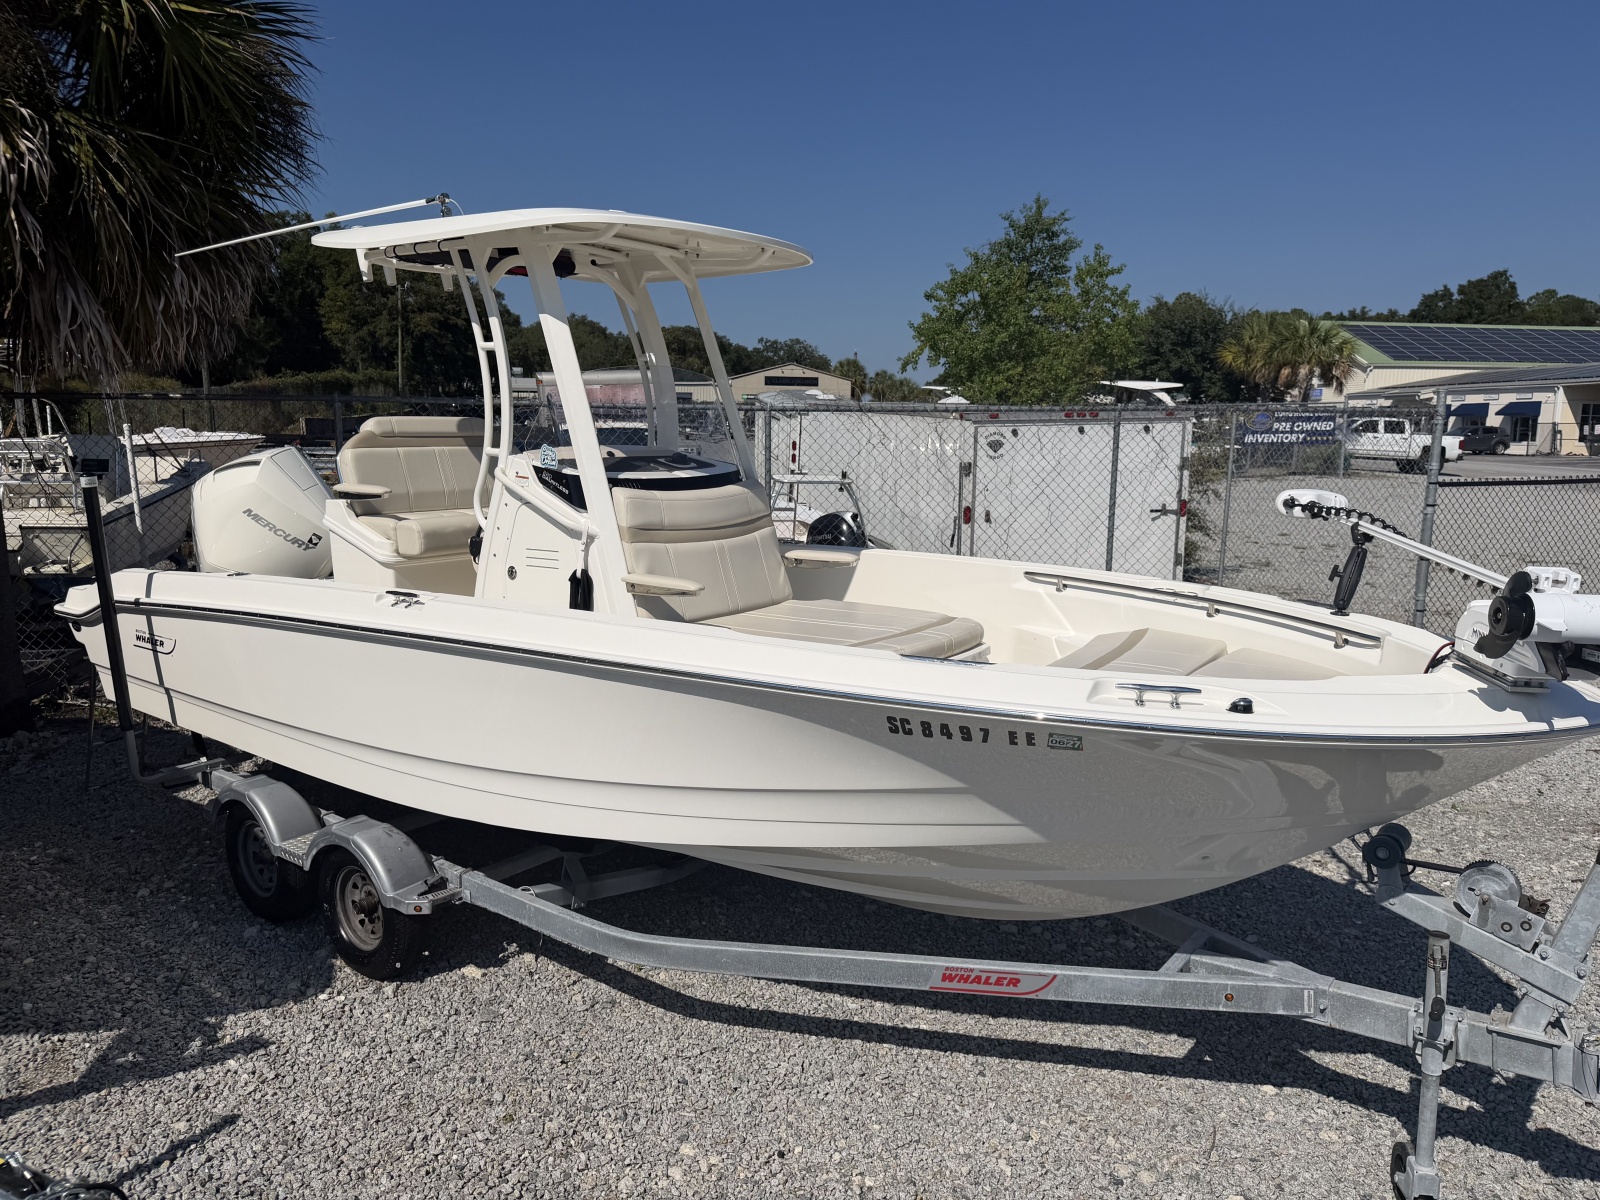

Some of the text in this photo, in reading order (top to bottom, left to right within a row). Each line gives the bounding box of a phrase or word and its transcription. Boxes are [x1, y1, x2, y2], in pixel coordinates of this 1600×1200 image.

[1272, 421, 1334, 432] PRE OWNED
[1244, 433, 1306, 443] INVENTORY
[242, 508, 317, 551] MERCURY
[135, 634, 165, 648] WHALER
[886, 716, 1036, 746] SC 8497 EE
[941, 973, 1021, 988] WHALER
